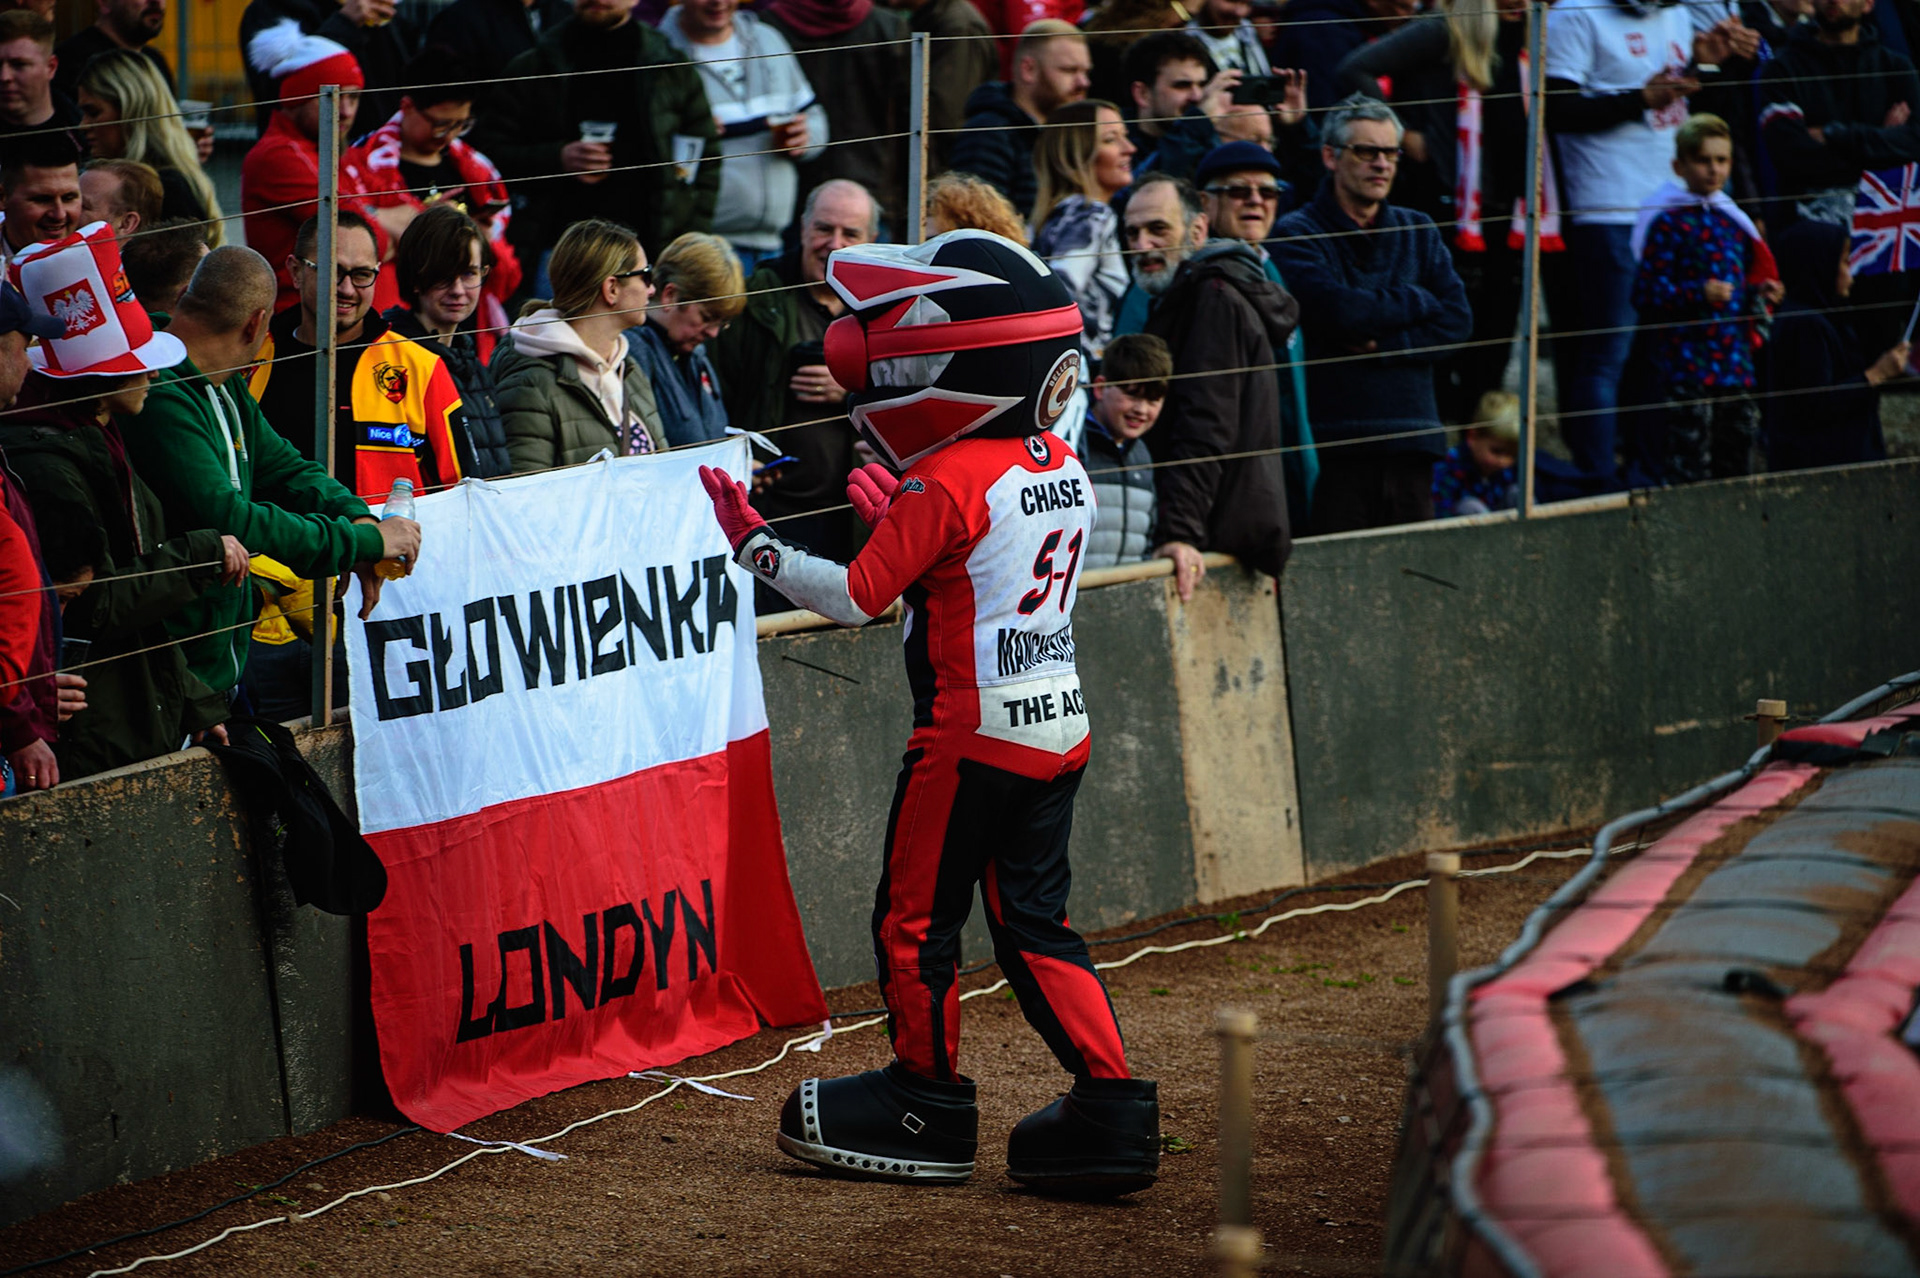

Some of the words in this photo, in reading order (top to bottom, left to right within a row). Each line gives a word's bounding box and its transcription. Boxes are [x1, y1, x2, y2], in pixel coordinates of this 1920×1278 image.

[370, 429, 392, 440] Nice
[1020, 478, 1084, 516] CHASE
[1003, 693, 1057, 728] THE
[1061, 688, 1088, 717] AC
[455, 878, 717, 1044] LONDYN
